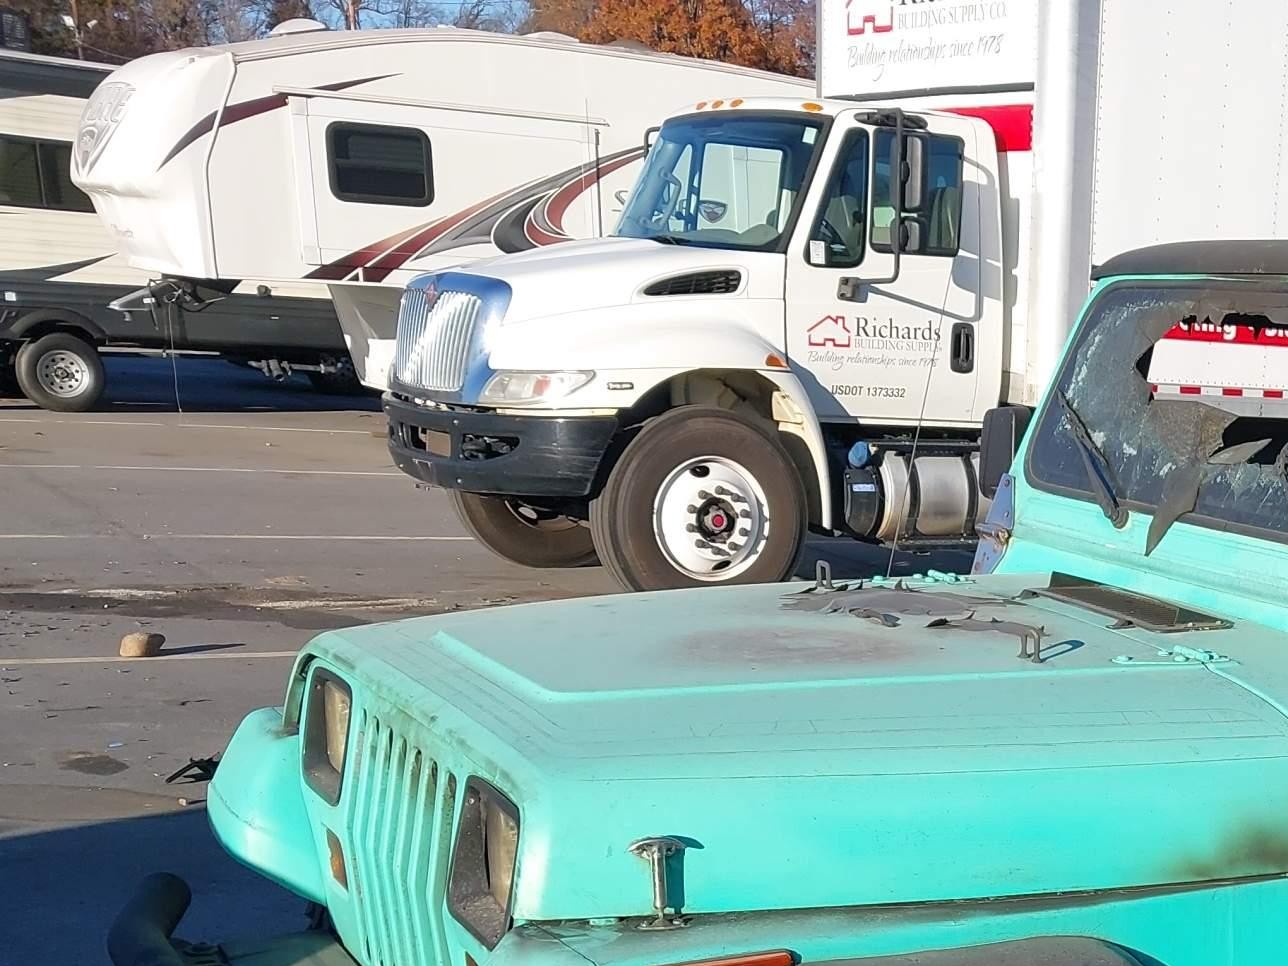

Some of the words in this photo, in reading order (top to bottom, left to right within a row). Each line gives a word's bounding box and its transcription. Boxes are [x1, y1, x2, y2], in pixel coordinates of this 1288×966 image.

[898, 8, 946, 29] BUILDING
[949, 4, 985, 24] SUPPLY
[847, 42, 887, 81] Building
[888, 36, 947, 64] relationships
[949, 39, 974, 58] since
[977, 33, 1004, 56] 1978
[855, 316, 941, 342] Richards
[854, 338, 904, 351] BUILDING
[807, 350, 845, 371] Building
[846, 352, 896, 369] relationships
[831, 384, 865, 396] USDOT
[866, 386, 906, 398] 1373332
